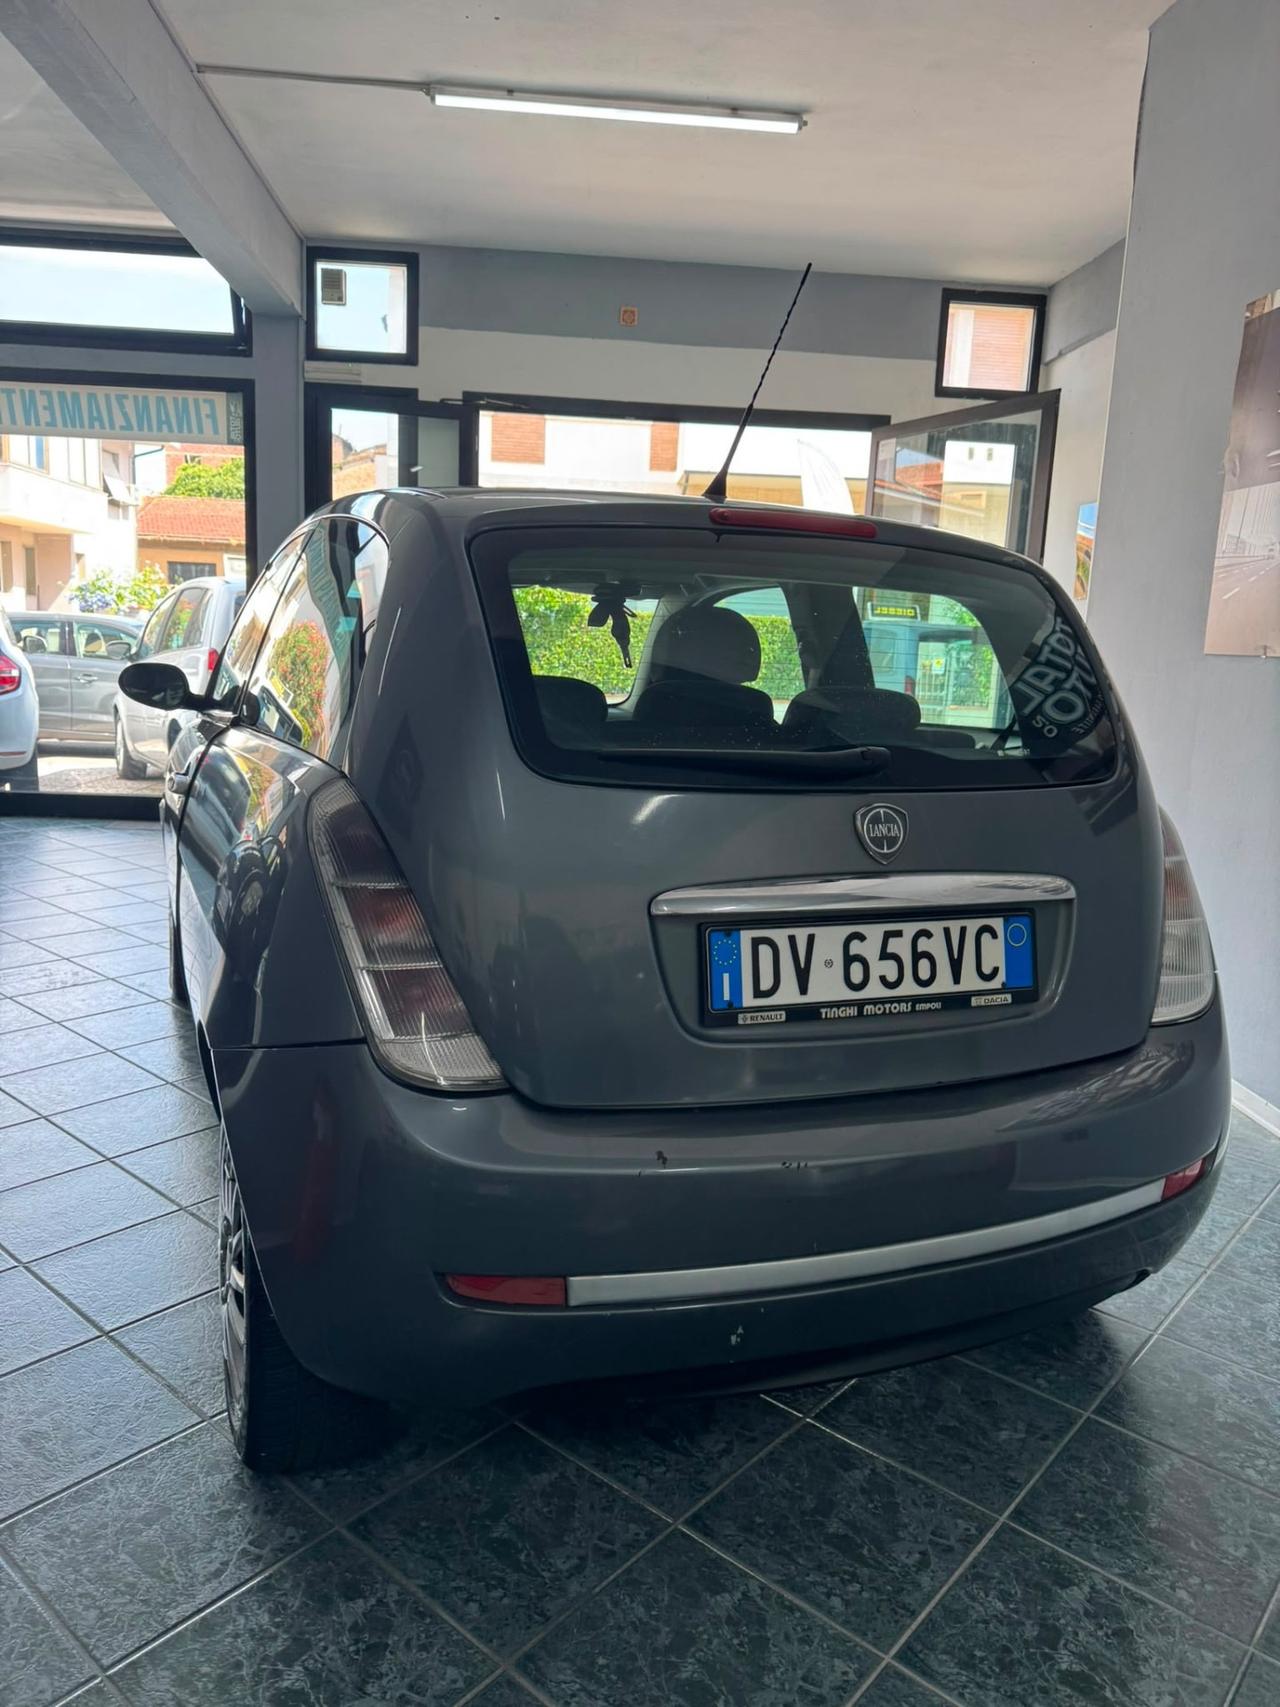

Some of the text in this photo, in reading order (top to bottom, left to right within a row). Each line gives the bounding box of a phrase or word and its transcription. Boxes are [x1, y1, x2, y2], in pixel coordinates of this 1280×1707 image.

[868, 823, 900, 837] LANCIA
[751, 933, 816, 999] DV
[842, 924, 1000, 993] 656VC
[983, 995, 1010, 1005] DACIA
[750, 1012, 785, 1023] RENAULT
[819, 1001, 942, 1020] TINGHI MOTORS EMPOLI
